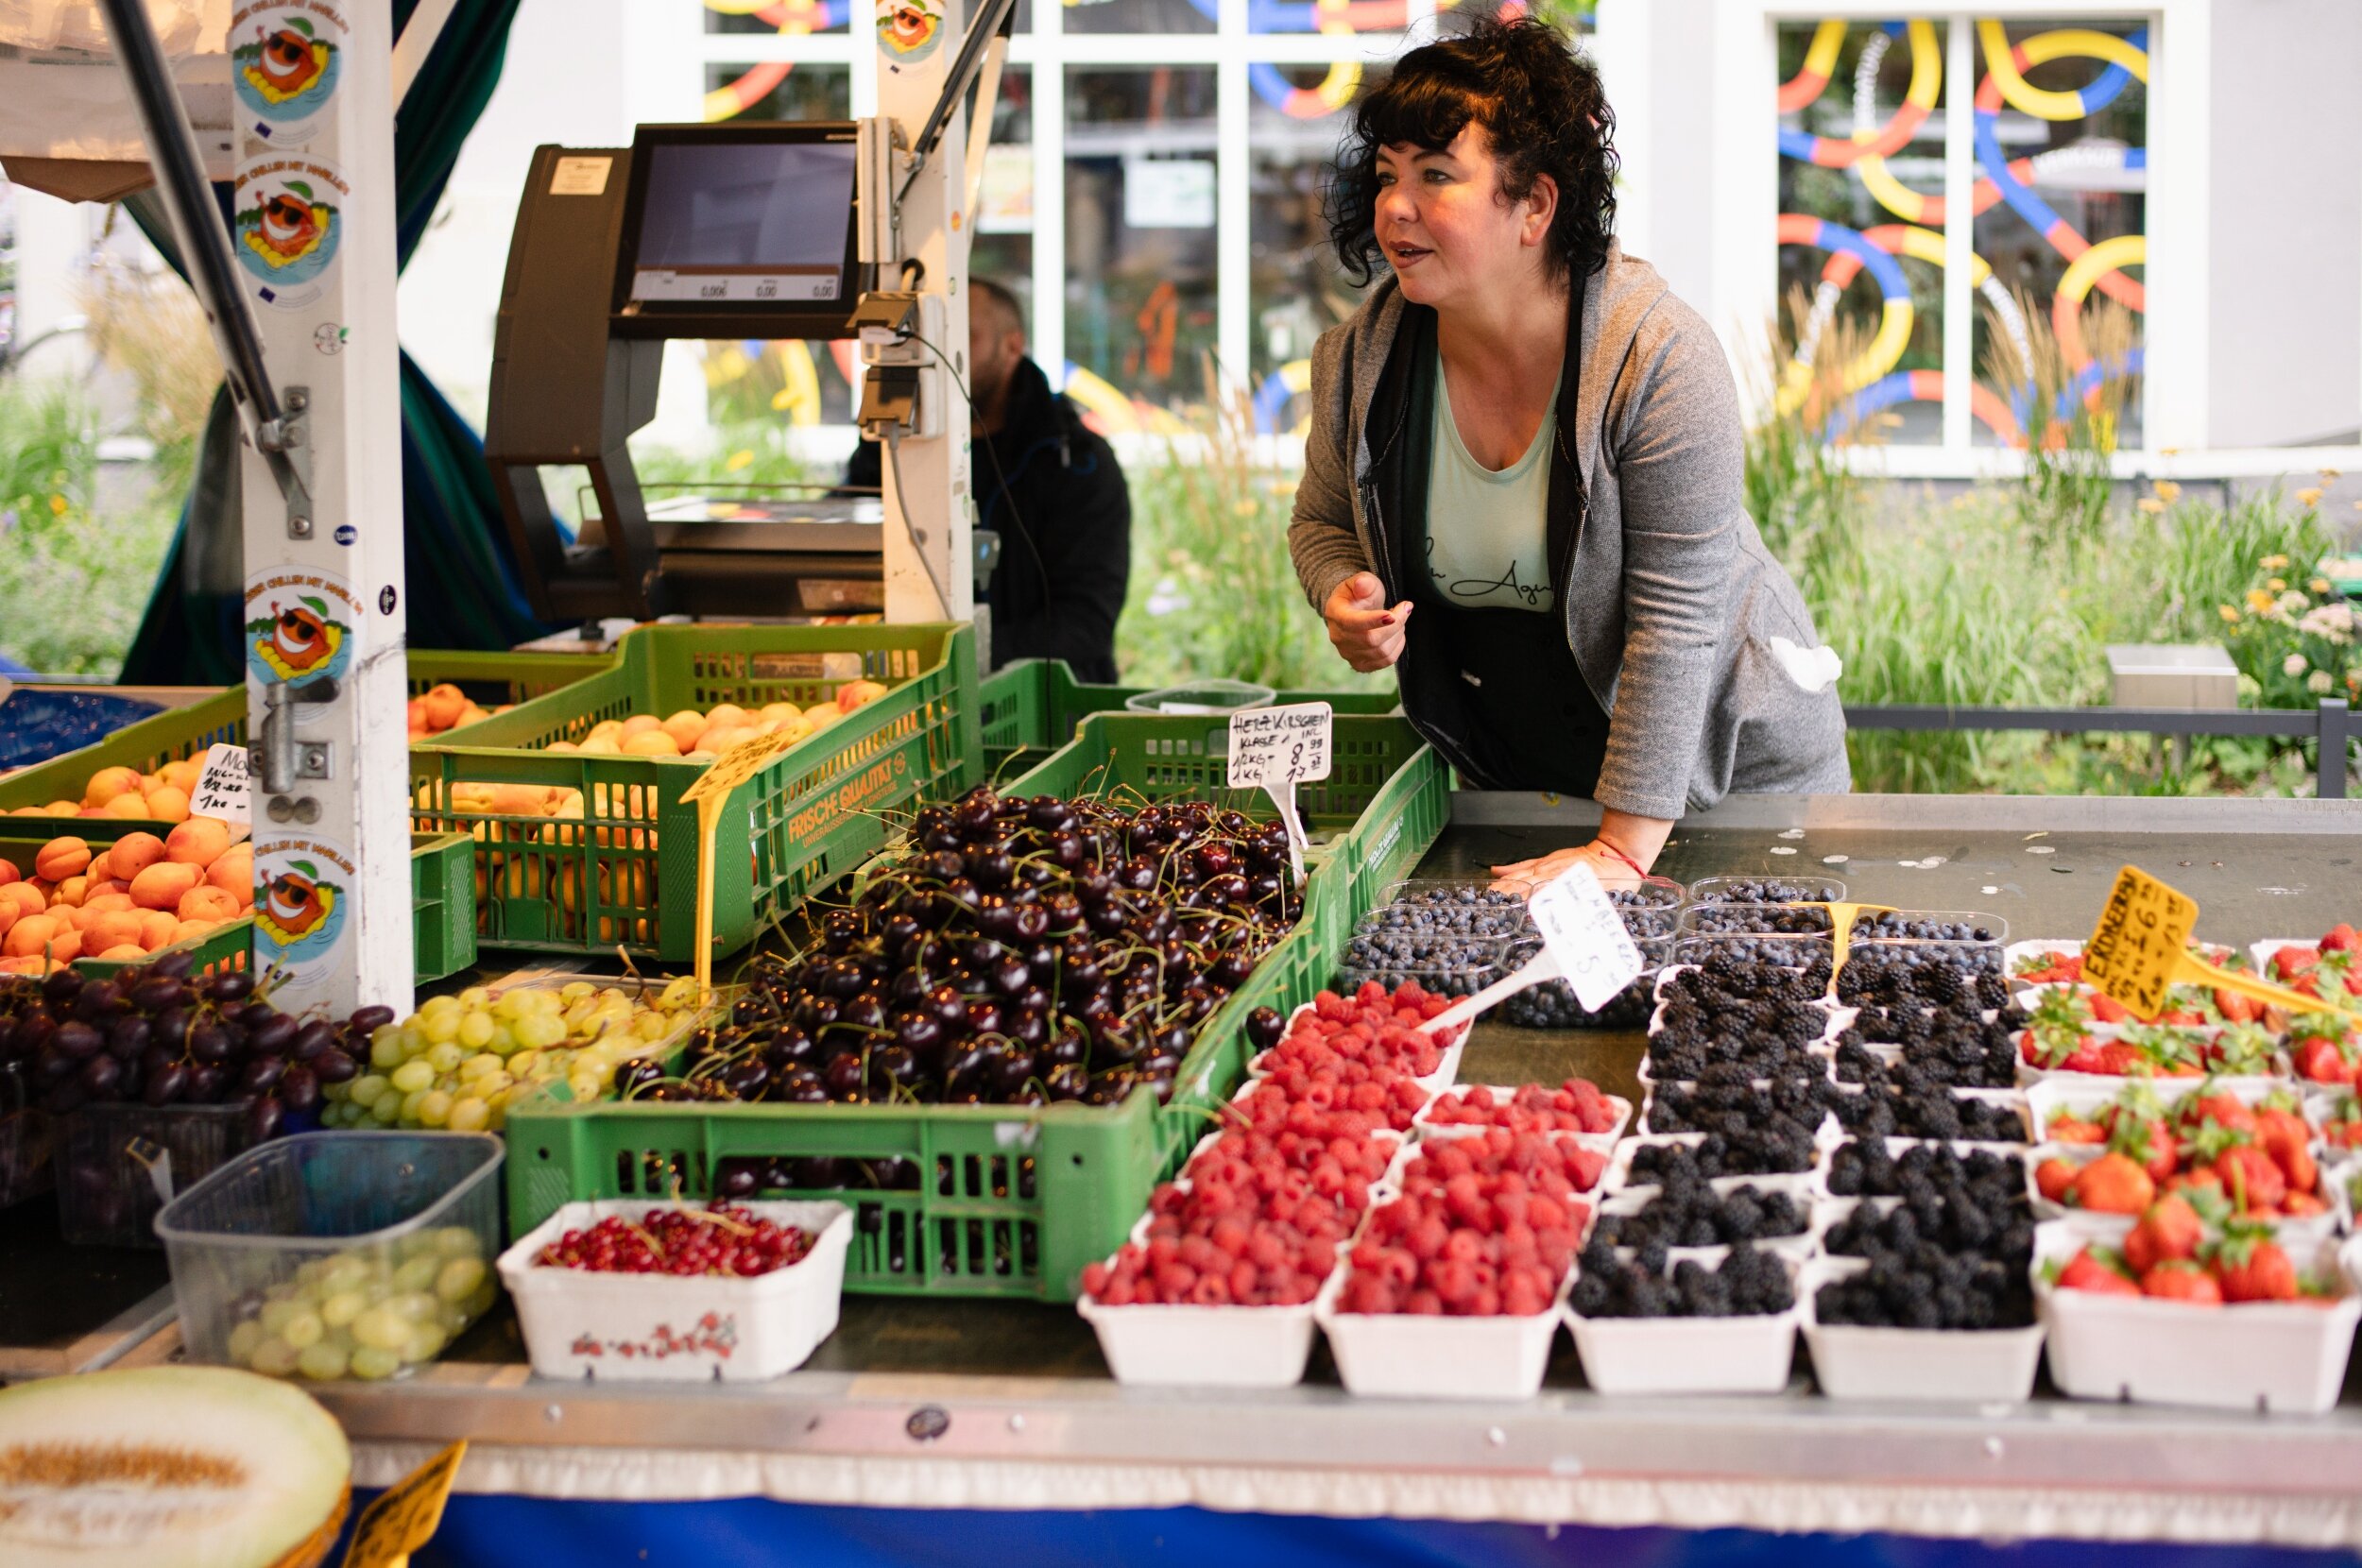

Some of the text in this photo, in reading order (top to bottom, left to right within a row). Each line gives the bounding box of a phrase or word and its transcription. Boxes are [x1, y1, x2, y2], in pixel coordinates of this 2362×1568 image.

[1291, 742, 1304, 766] 8
[293, 840, 310, 851] MIT
[2135, 907, 2158, 929] 6
